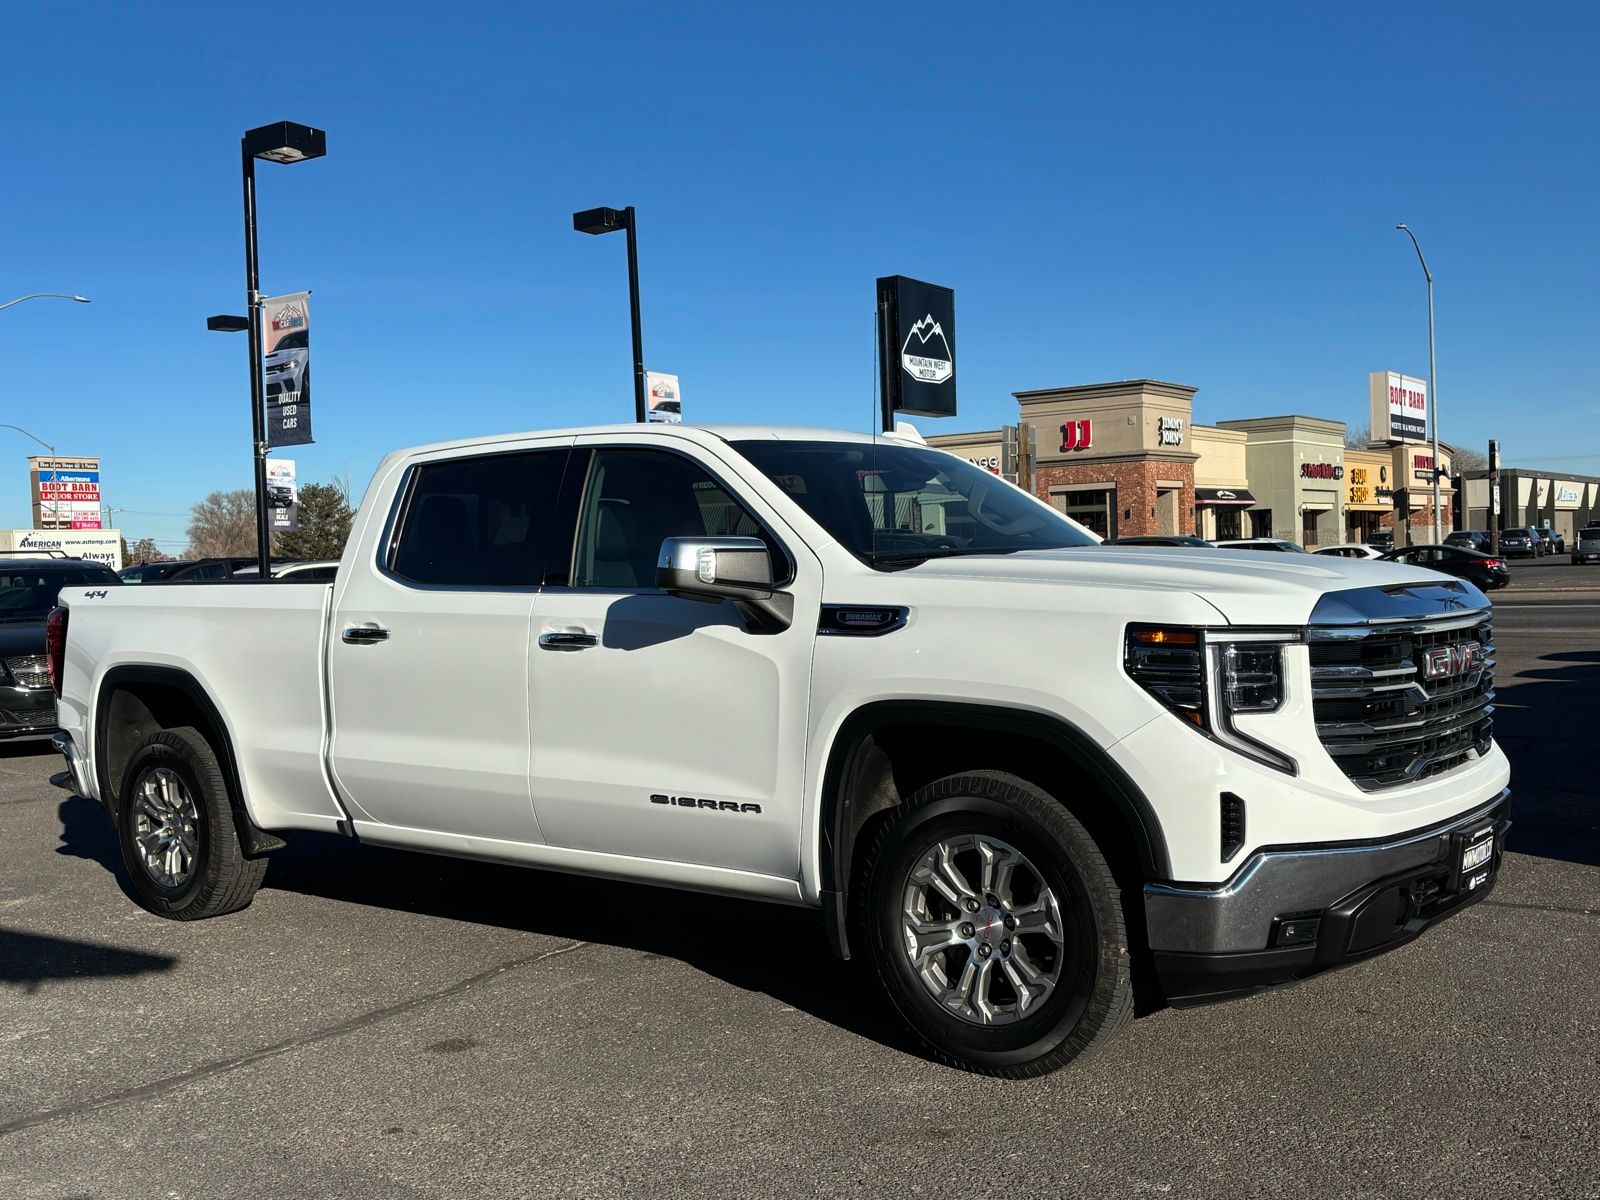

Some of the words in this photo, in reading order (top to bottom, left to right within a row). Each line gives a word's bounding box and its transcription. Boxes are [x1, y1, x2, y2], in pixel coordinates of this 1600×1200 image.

[909, 356, 933, 368] MOUNTAIN
[933, 359, 947, 370] WEST
[919, 368, 937, 379] MOTOR
[279, 391, 301, 405] QUALITY
[1390, 385, 1407, 407] BOOT
[1408, 389, 1425, 411] BARN
[282, 404, 297, 416] USED
[282, 417, 298, 429] CARS
[1161, 416, 1183, 430] JIMMY
[1064, 419, 1093, 449] JJ
[1161, 430, 1184, 445] JOHN'S
[42, 483, 69, 491] BOOT
[72, 483, 98, 492] BARN
[19, 540, 62, 548] AMERICAN
[82, 552, 115, 561] Always
[1422, 641, 1481, 681] GMC
[649, 794, 762, 814] SIERRA
